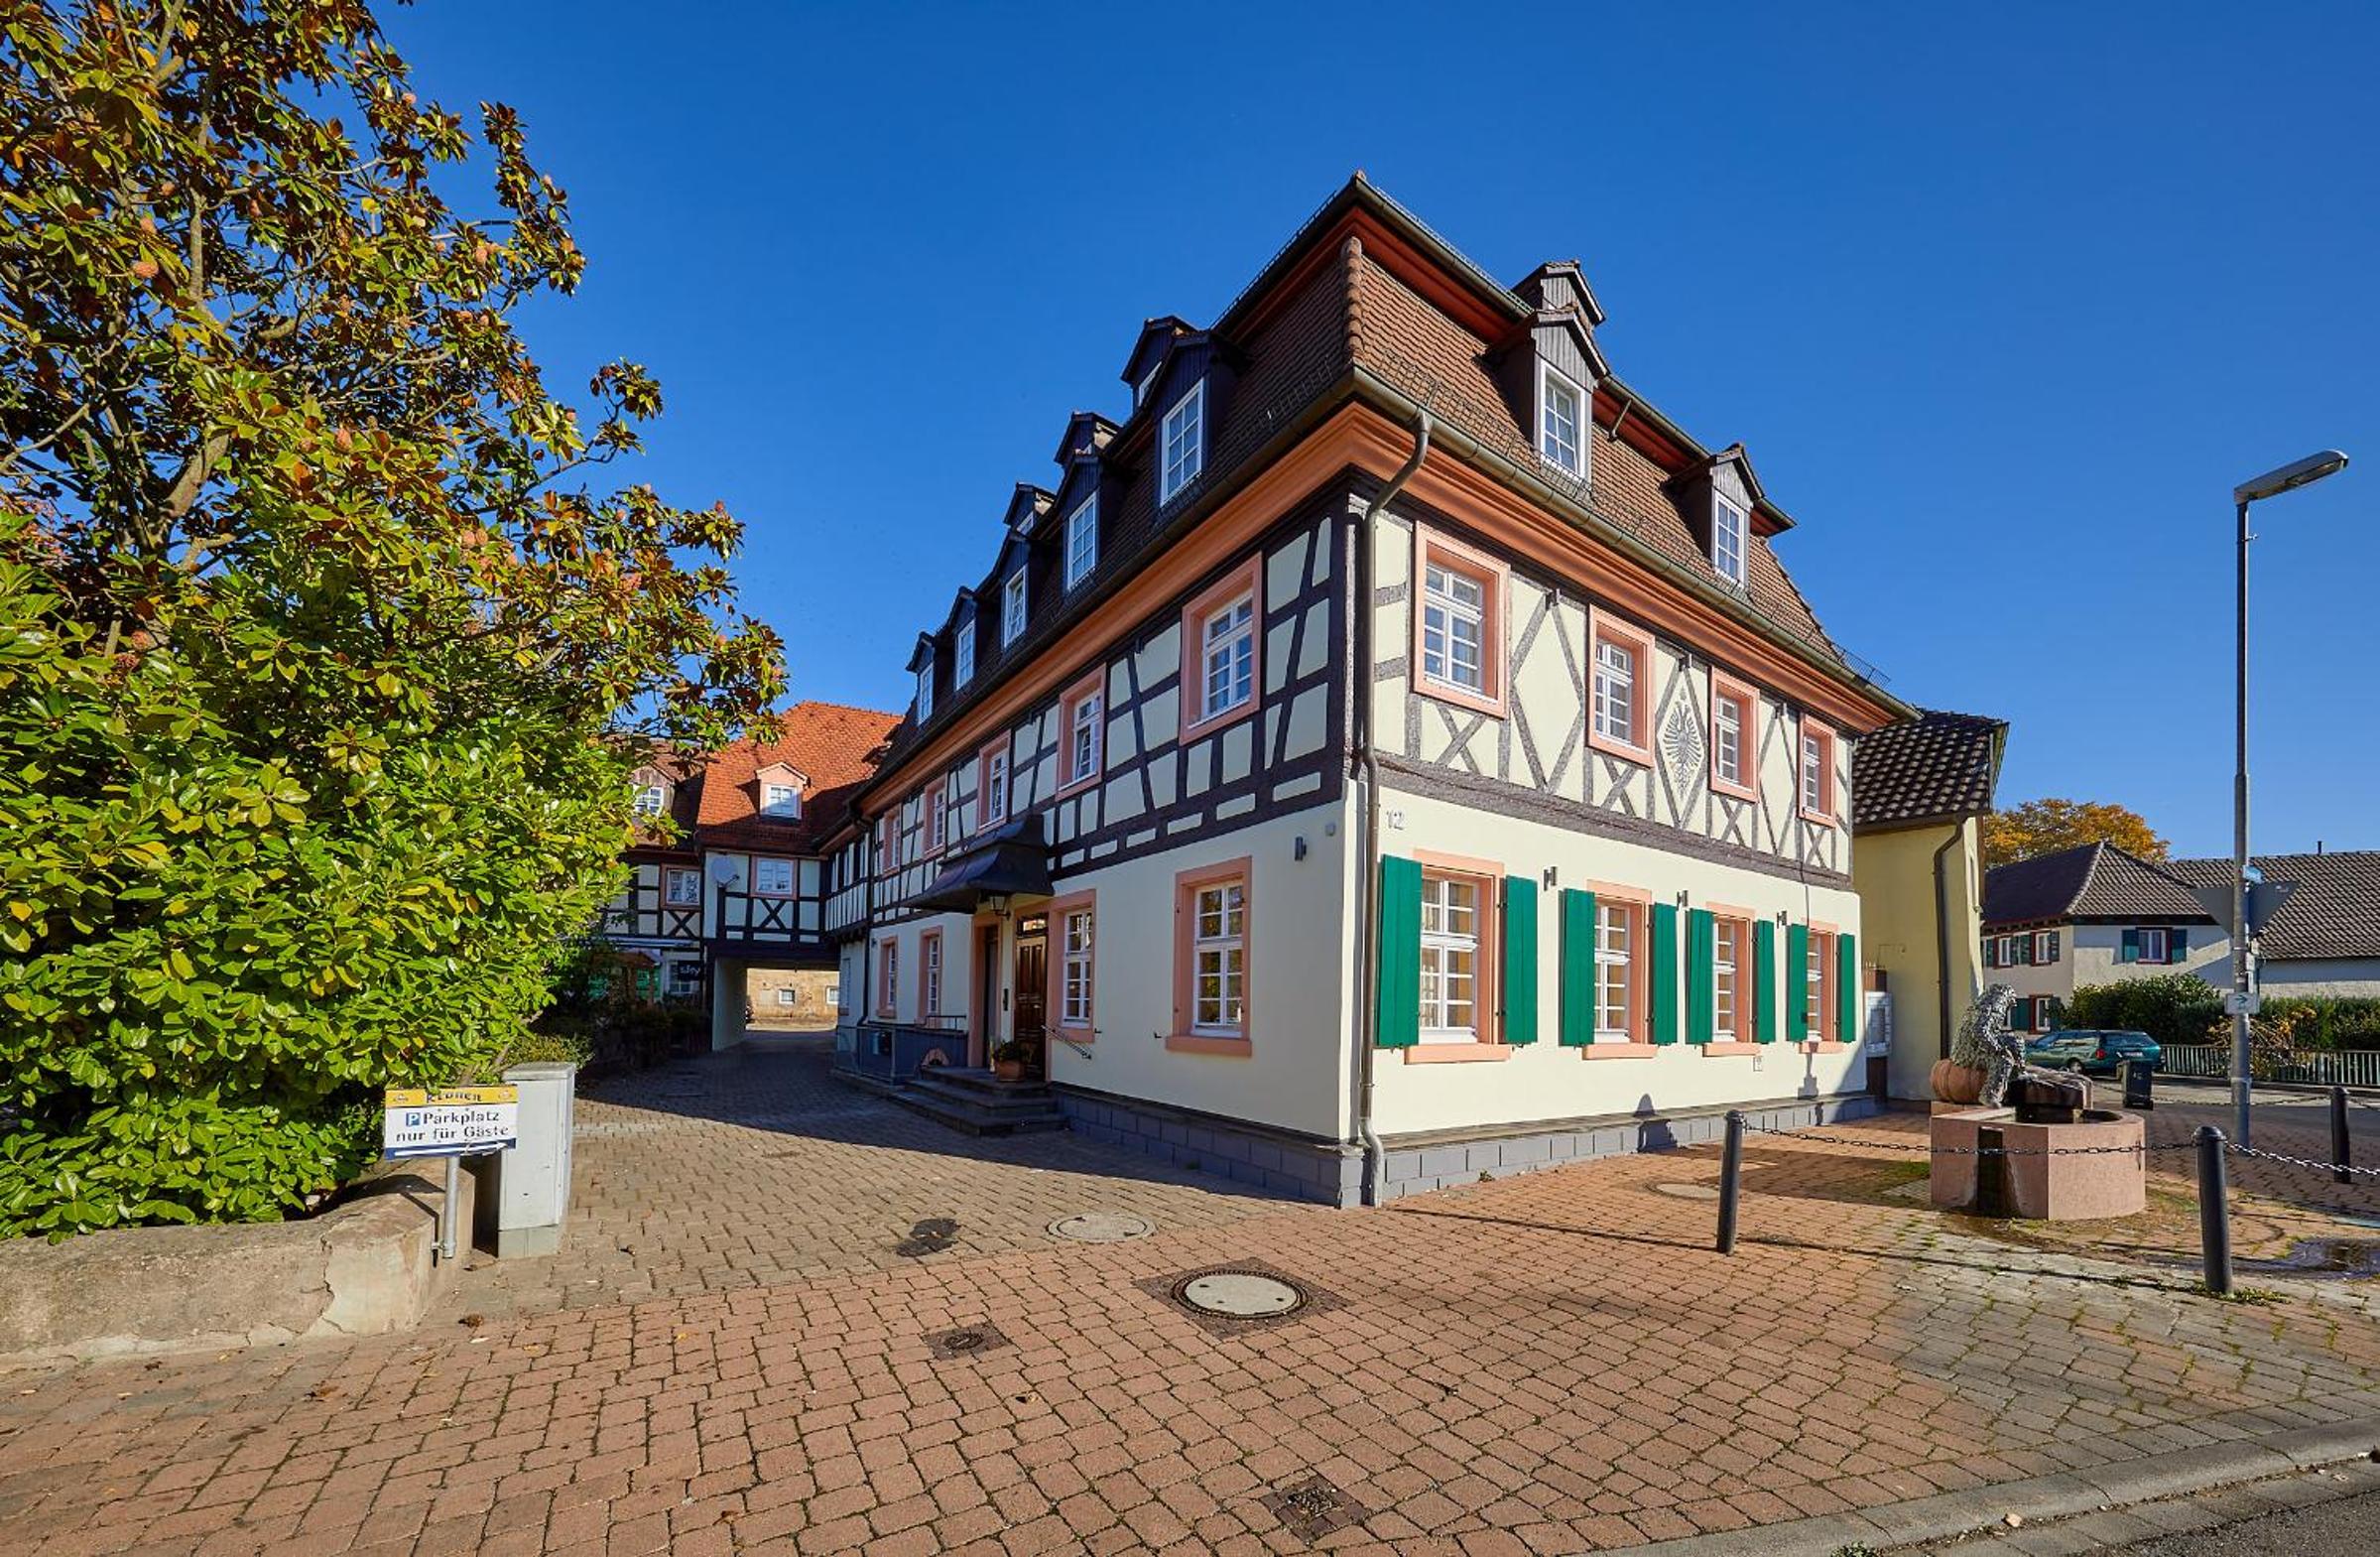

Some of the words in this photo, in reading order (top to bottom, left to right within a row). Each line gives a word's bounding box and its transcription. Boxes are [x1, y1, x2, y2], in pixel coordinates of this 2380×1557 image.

[424, 1110, 500, 1125] Parkplatz
[396, 1131, 426, 1142] nur
[434, 1127, 457, 1140] für
[463, 1125, 509, 1138] Gäste
